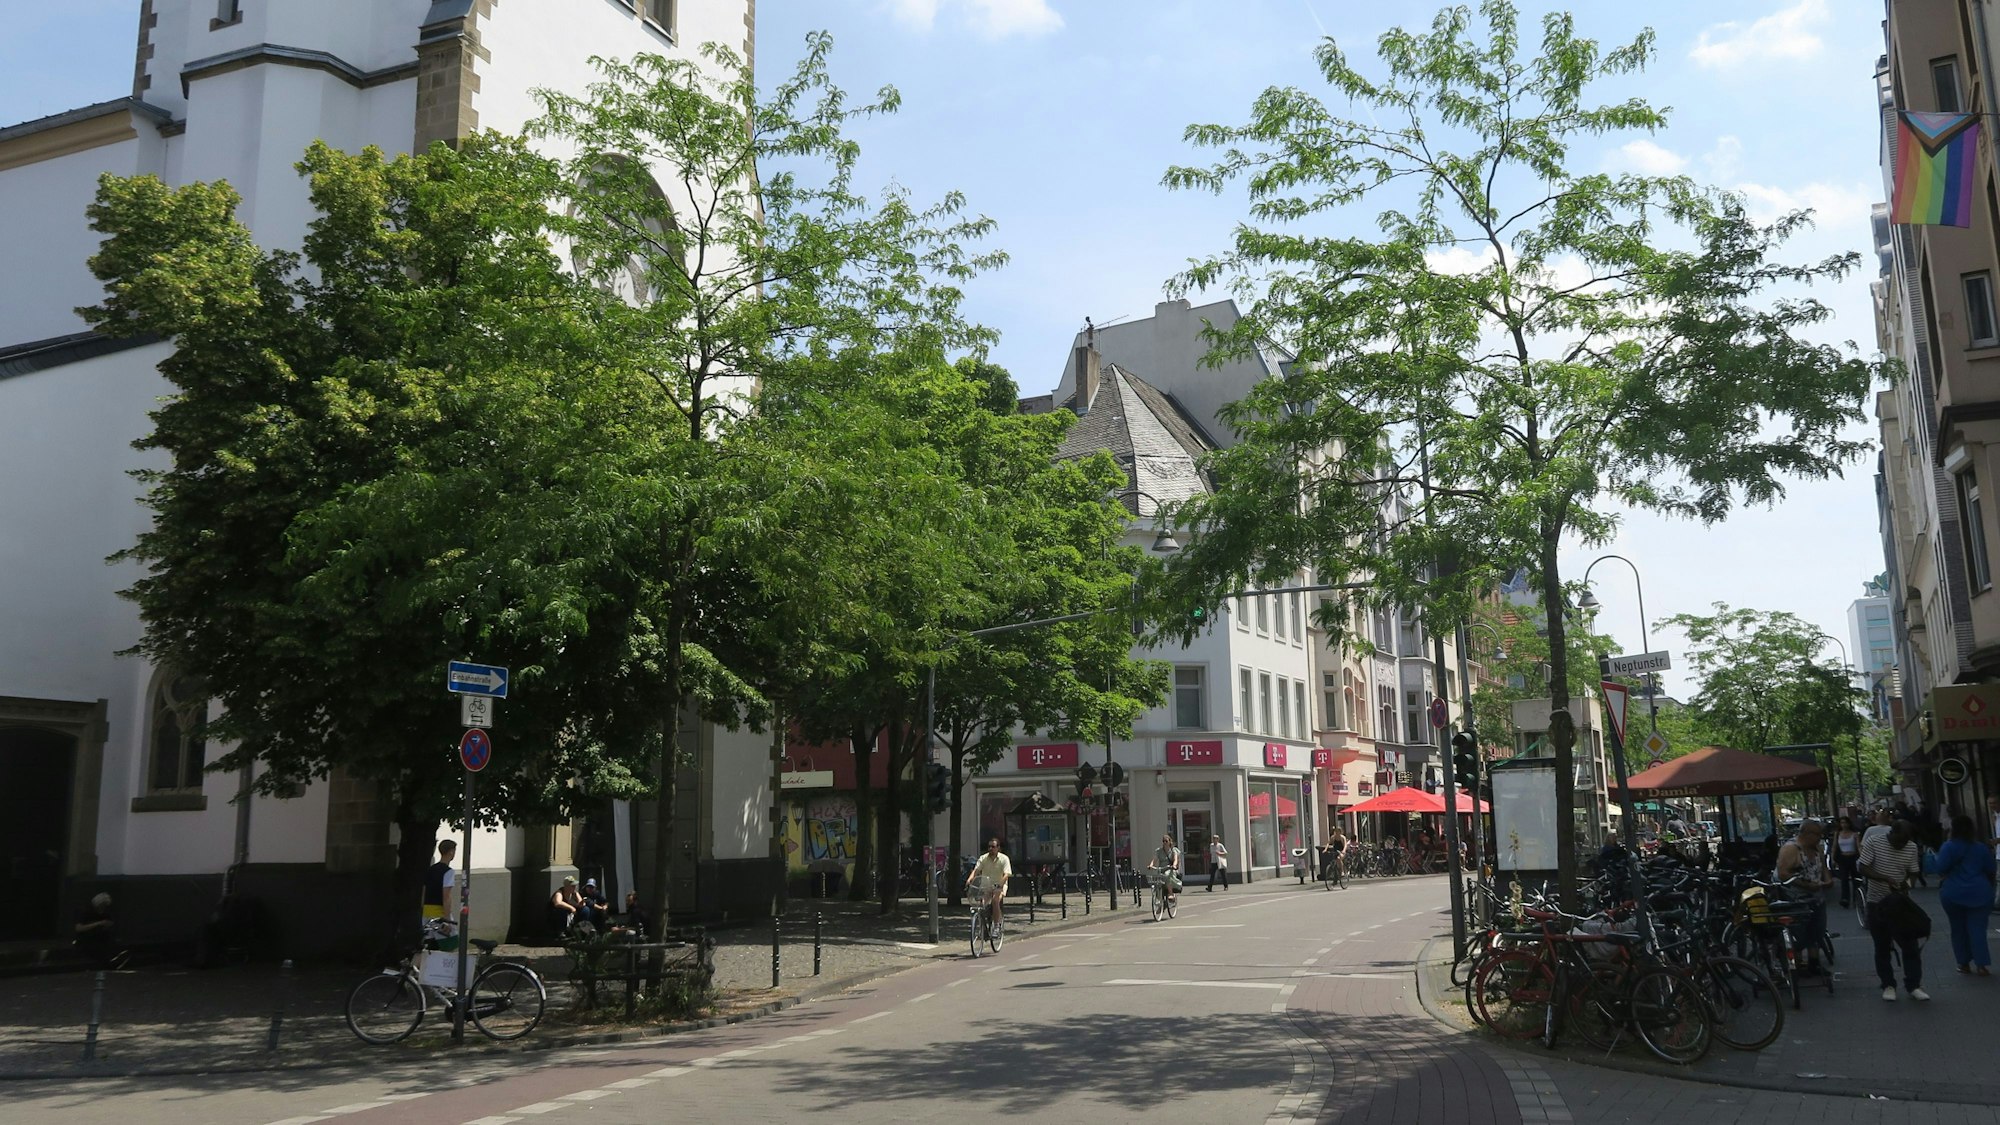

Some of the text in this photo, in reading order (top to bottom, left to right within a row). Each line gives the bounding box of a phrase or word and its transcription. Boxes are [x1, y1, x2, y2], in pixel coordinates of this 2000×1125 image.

[1613, 657, 1667, 673] Neptunstr.
[1743, 777, 1795, 791] Damla
[1648, 786, 1698, 797] Damla
